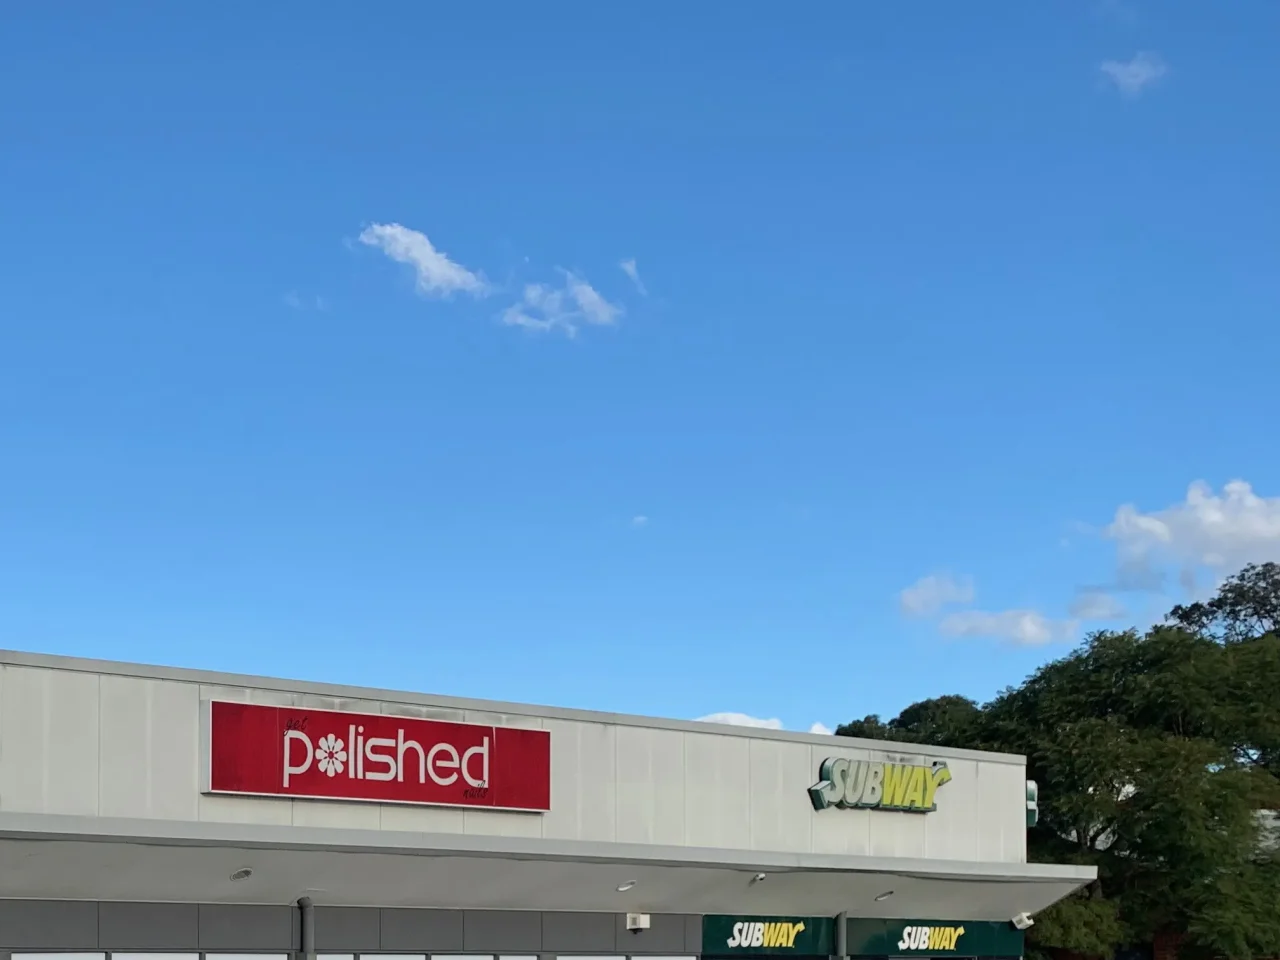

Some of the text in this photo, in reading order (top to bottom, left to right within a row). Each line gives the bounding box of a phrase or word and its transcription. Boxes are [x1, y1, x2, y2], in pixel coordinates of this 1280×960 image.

[807, 757, 954, 811] SUBWAY
[727, 921, 805, 948] SUBWAY
[898, 925, 965, 951] SUBWAY
